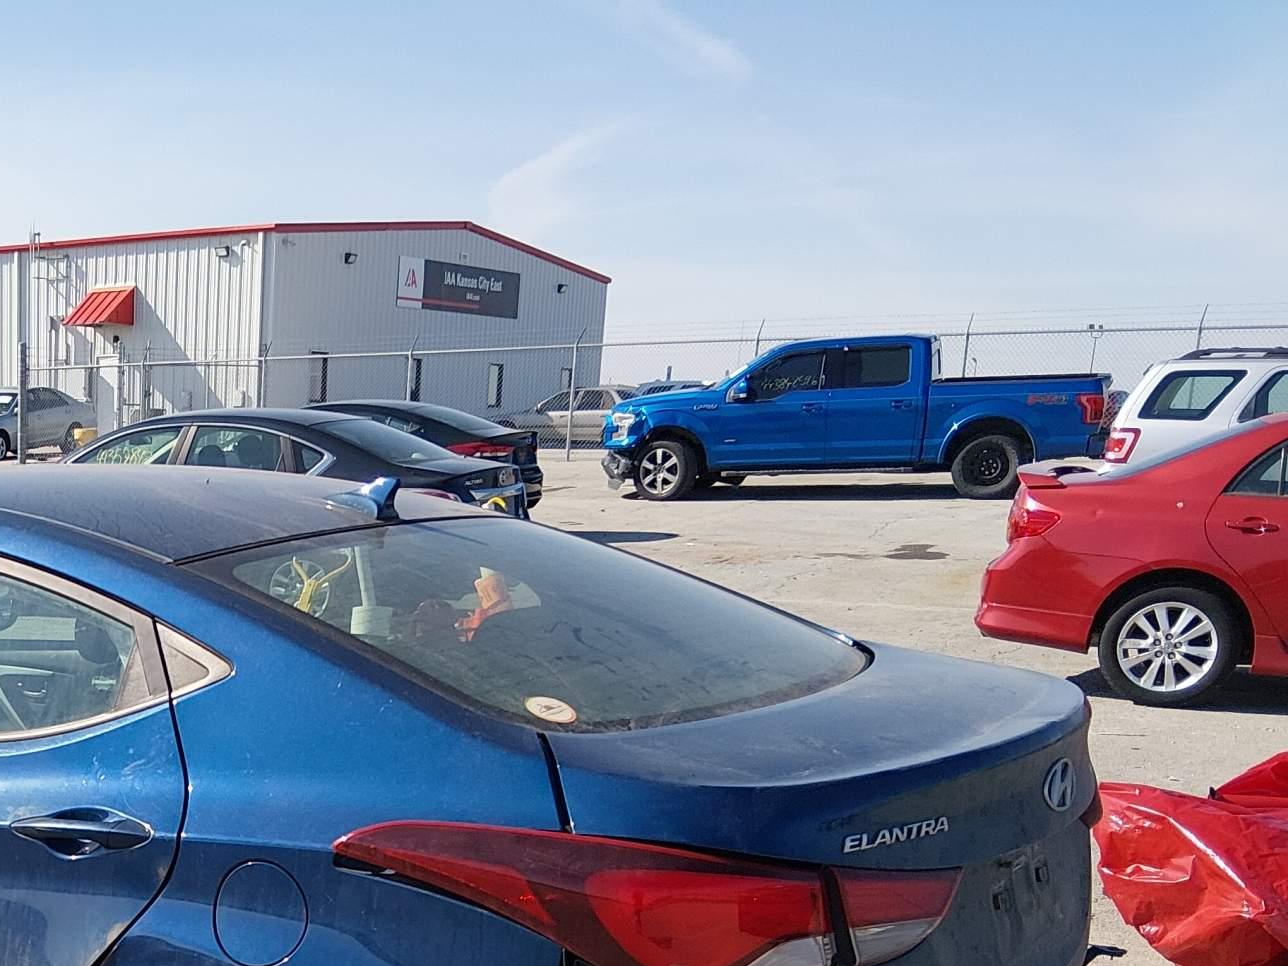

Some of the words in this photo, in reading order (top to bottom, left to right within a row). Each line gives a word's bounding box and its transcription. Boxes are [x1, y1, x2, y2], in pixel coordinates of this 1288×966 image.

[444, 271, 455, 286] IAA
[456, 273, 477, 288] Kansas
[478, 276, 490, 293] City
[490, 277, 502, 292] East
[843, 816, 950, 853] ELANTRA
